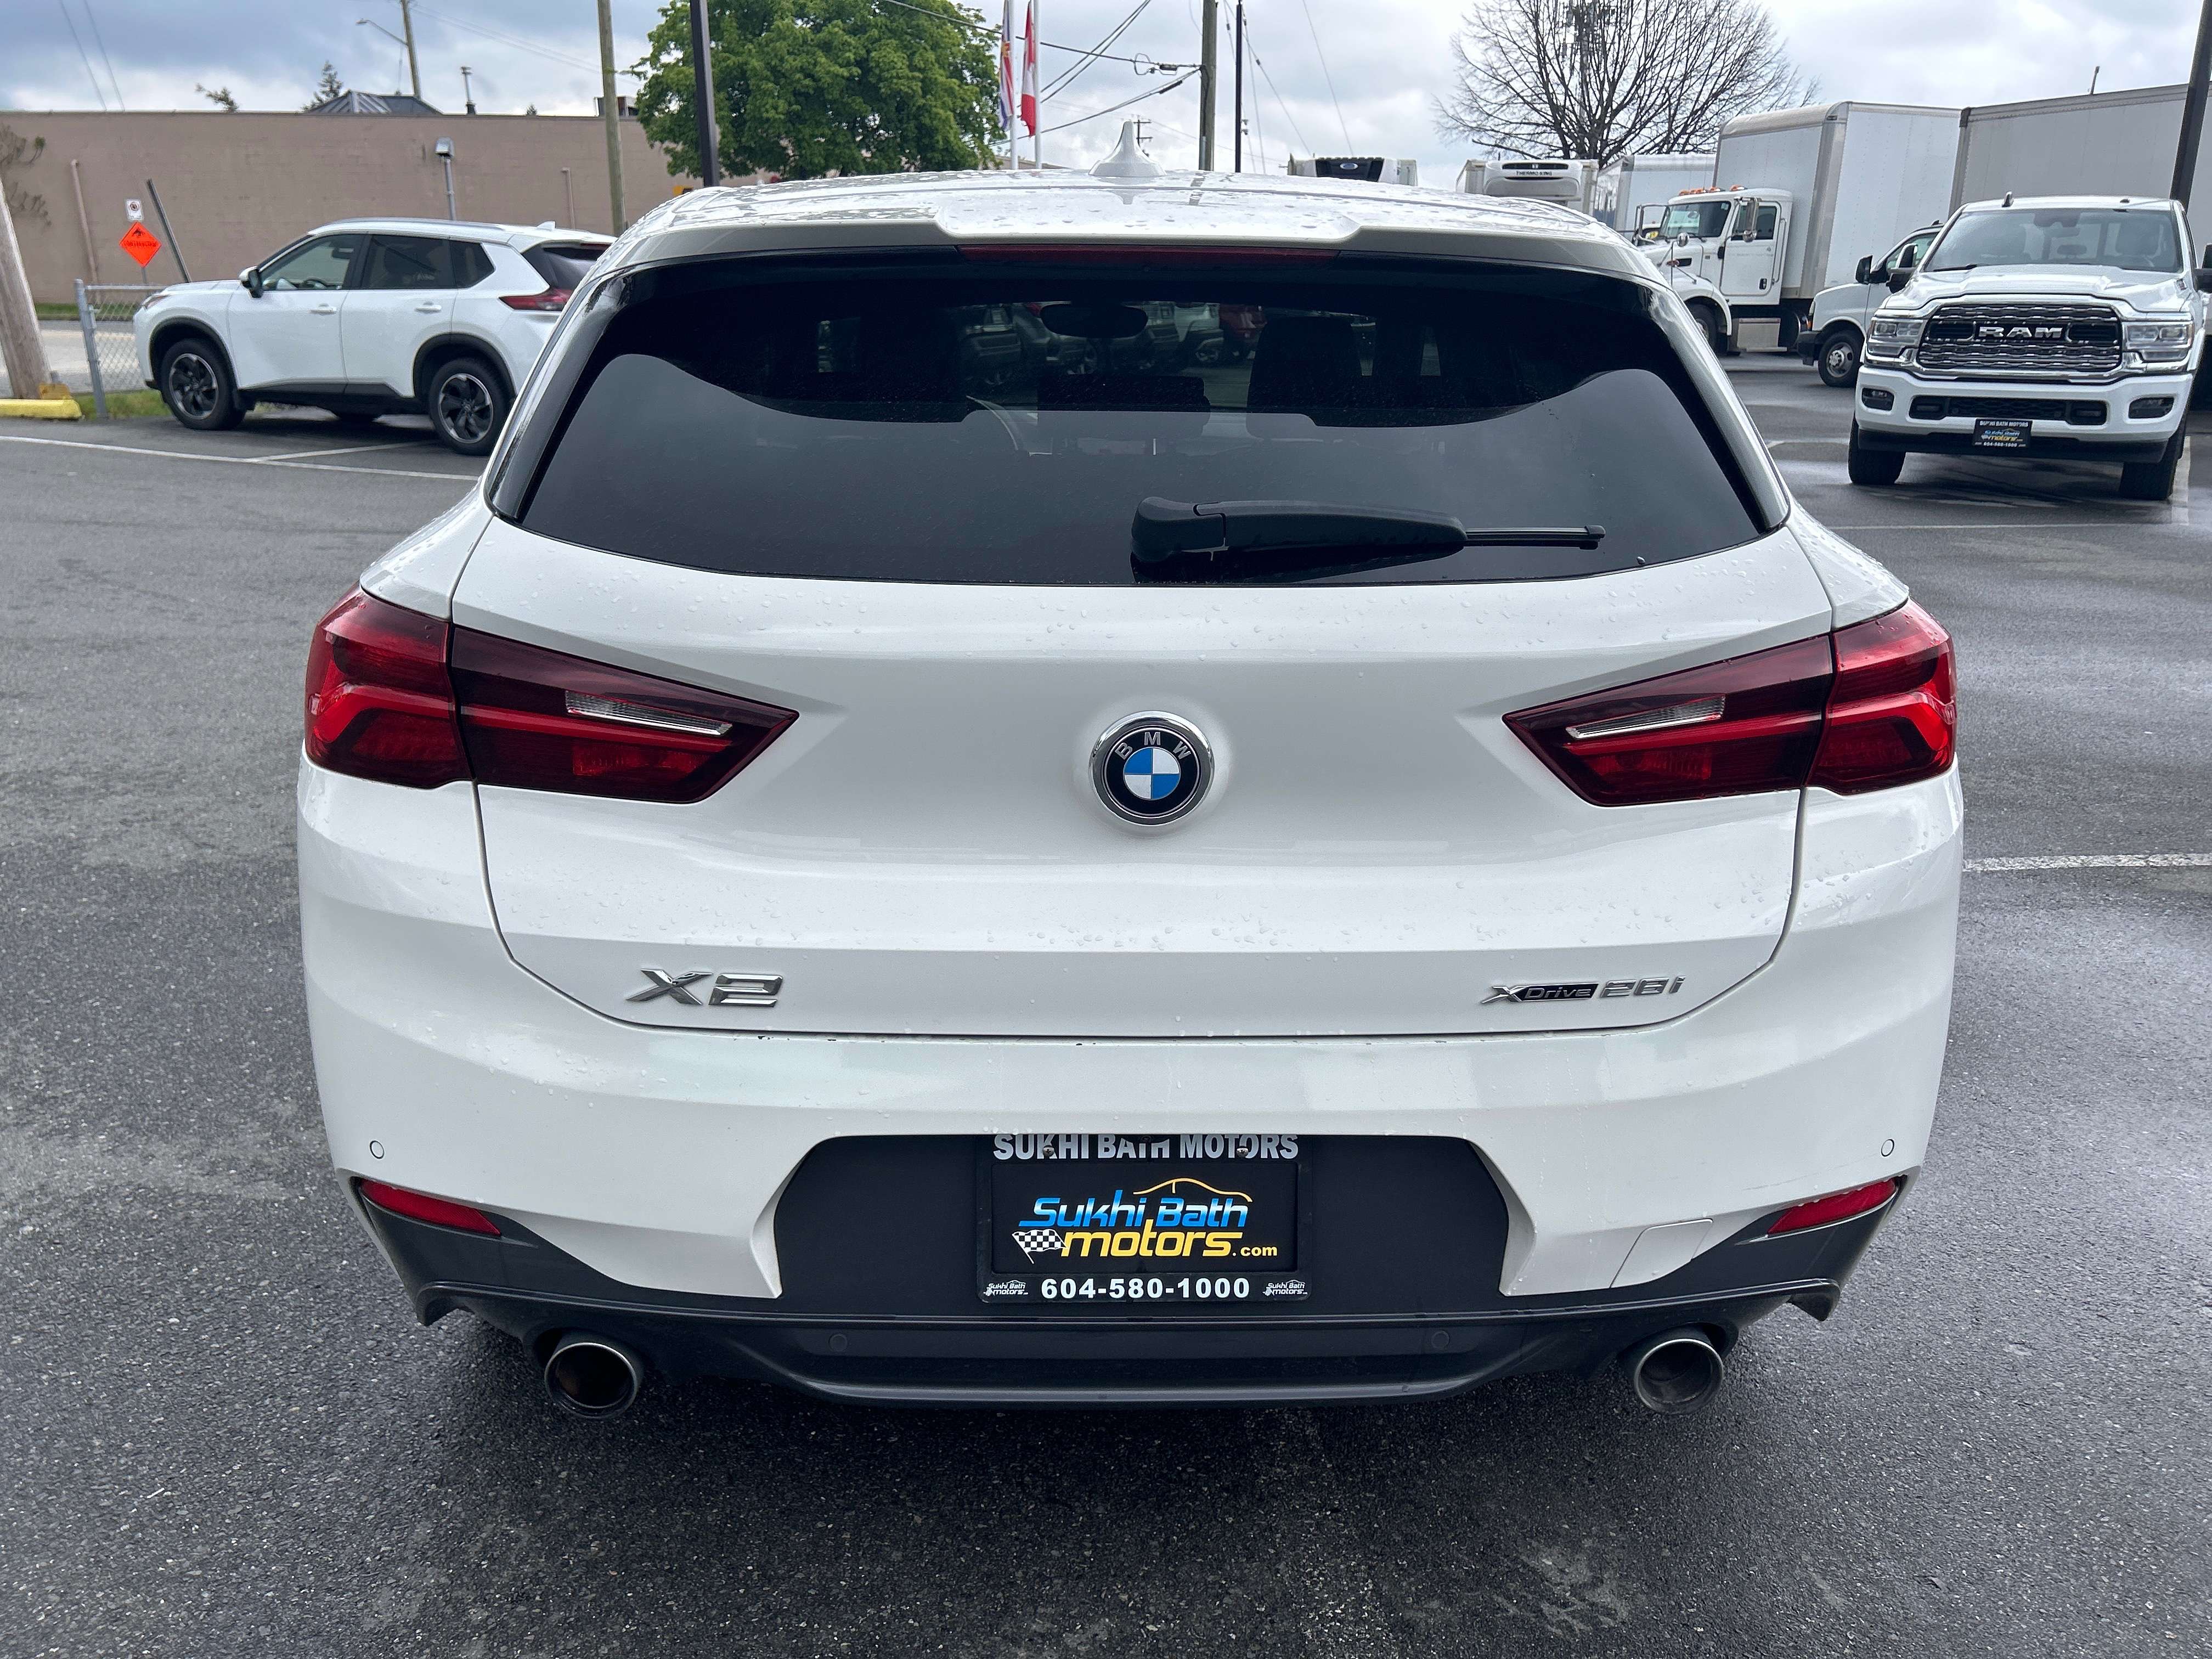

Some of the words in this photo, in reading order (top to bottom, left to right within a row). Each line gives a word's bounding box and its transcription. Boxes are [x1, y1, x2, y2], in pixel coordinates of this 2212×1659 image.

[1978, 326, 2063, 338] RAM
[1114, 731, 1192, 760] BMW
[625, 968, 783, 1008] X2
[993, 1133, 1089, 1160] SUKHI
[1180, 1133, 1299, 1159] MOTORS
[1018, 1189, 1147, 1227] Sukhi
[1155, 1197, 1248, 1227] Bath
[1041, 1277, 1250, 1299] 604-580-1000
